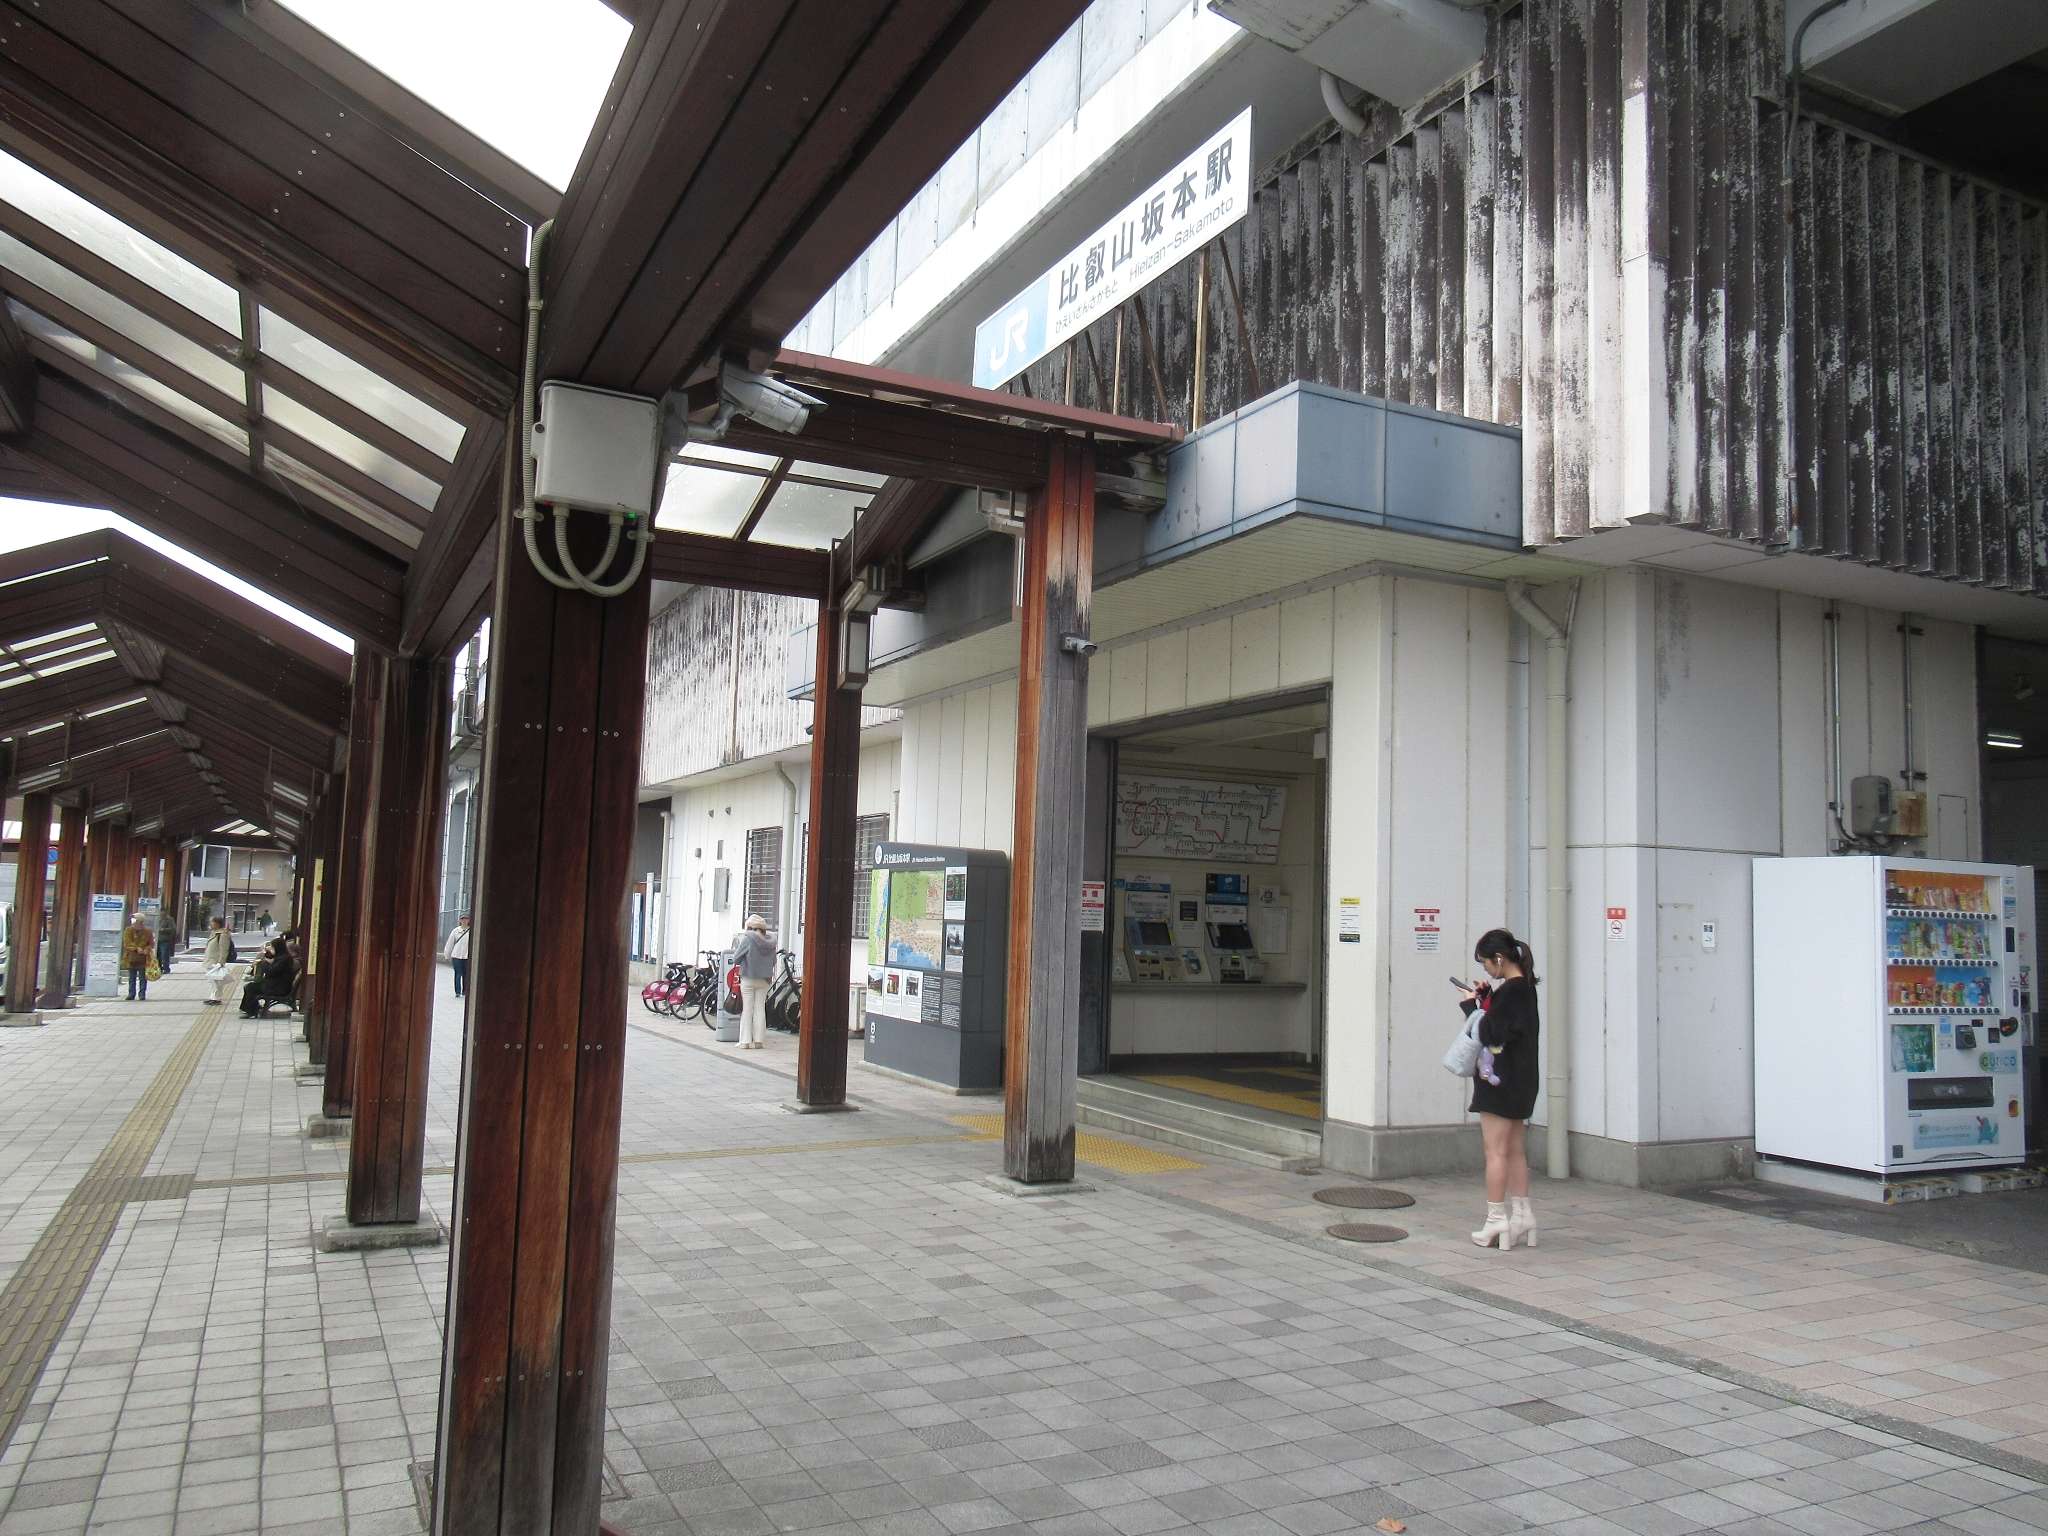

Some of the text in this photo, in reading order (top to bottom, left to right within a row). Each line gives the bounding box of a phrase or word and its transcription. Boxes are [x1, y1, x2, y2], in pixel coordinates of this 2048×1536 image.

[1059, 137, 1232, 310] 比叡山坂本駅
[1130, 196, 1233, 281] Hieizan-Sakamoto
[990, 307, 1029, 371] JR
